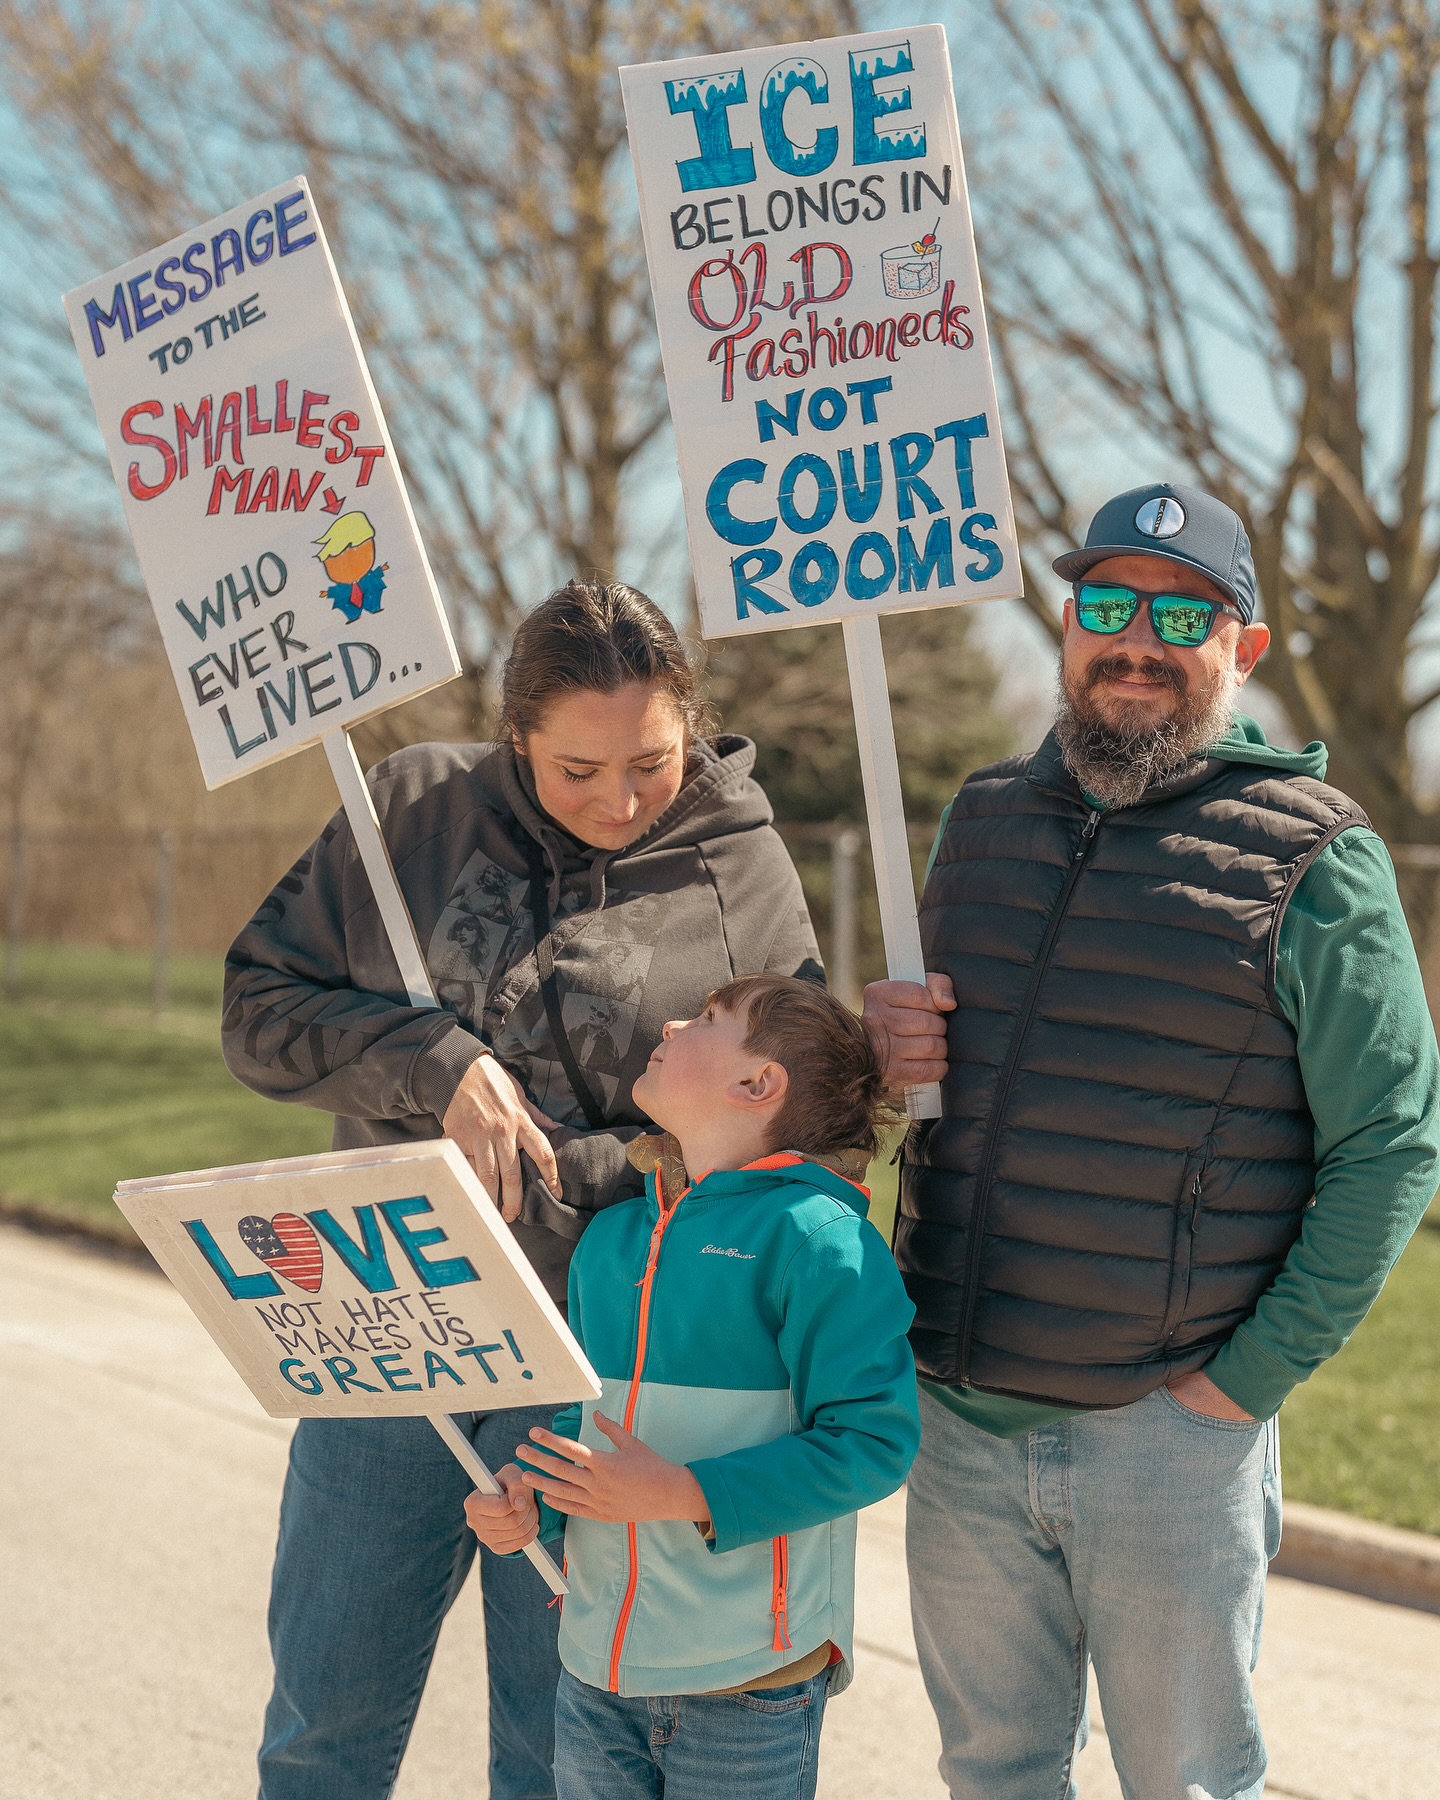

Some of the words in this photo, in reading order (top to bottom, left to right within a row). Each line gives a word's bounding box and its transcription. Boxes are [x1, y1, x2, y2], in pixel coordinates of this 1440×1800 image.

[662, 41, 926, 192] ICE
[670, 174, 886, 251] BELONGS
[901, 164, 952, 213] IN
[84, 191, 317, 358] MESSAGE
[687, 241, 853, 332] OLD
[148, 336, 193, 374] TO
[195, 293, 266, 350] THE
[708, 280, 974, 402] Fashioneds
[120, 378, 384, 500] SMALLEST
[755, 376, 891, 443] NOT
[206, 464, 325, 516] MAN
[705, 413, 988, 546] COURT
[176, 551, 288, 642] WHO
[730, 512, 1003, 620] ROOMS
[187, 609, 311, 706] EVER
[217, 641, 422, 758] LIVED...
[725, 1247, 756, 1259] Bauer
[255, 1301, 323, 1332] NOT
[343, 1290, 449, 1325] HATE
[274, 1324, 412, 1356] MAKES
[421, 1317, 475, 1347] US
[279, 1329, 533, 1396] GREAT!
